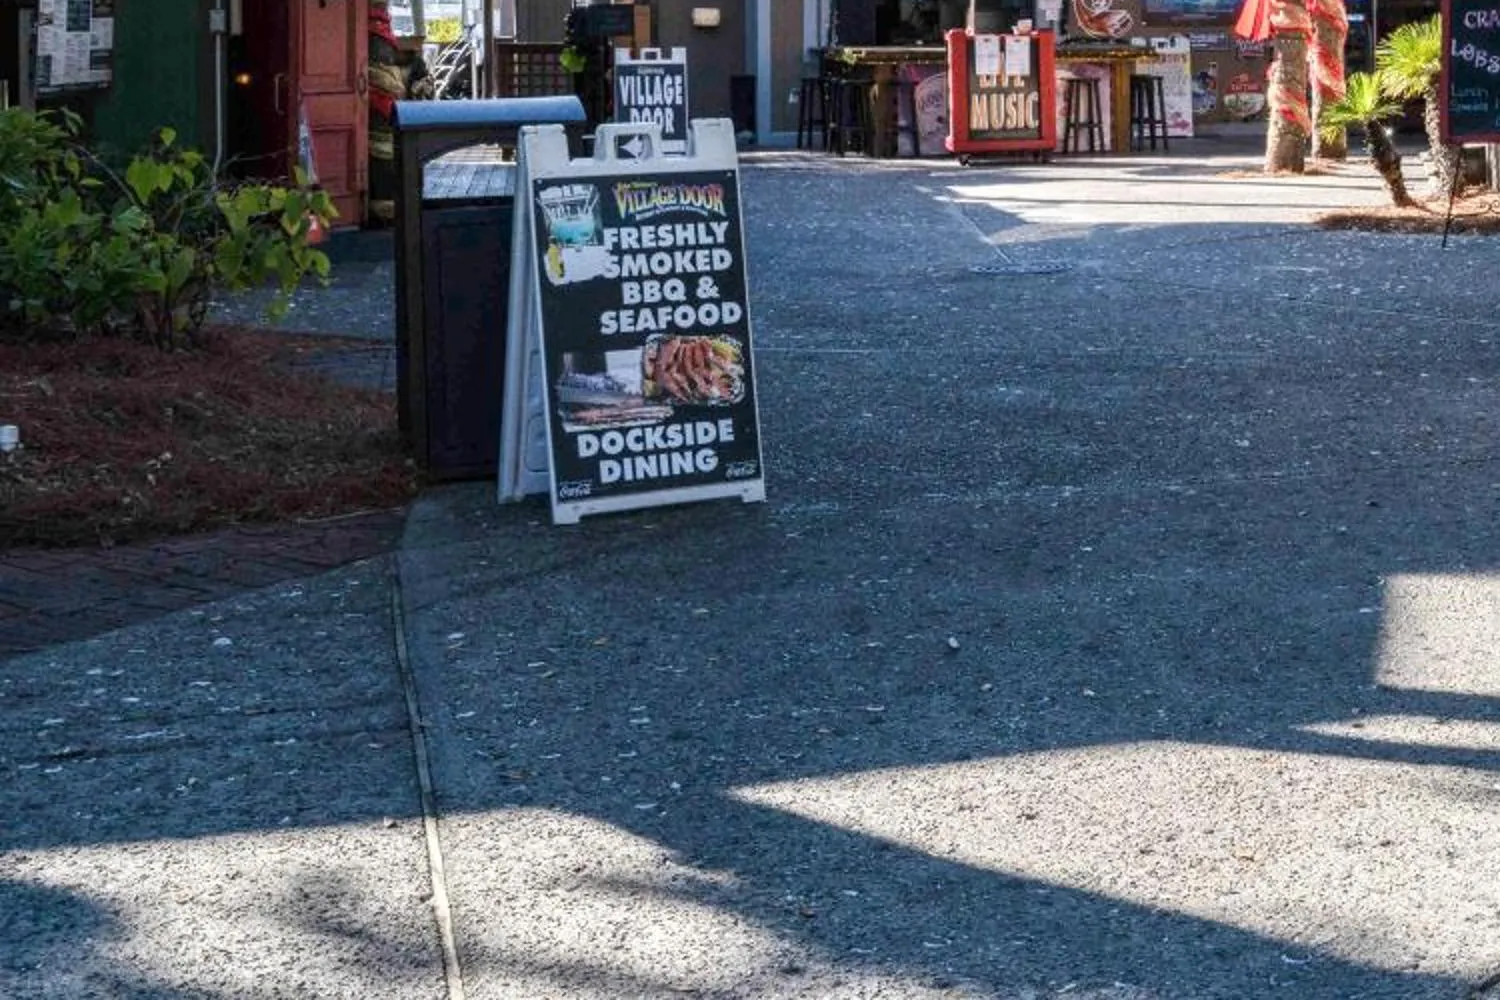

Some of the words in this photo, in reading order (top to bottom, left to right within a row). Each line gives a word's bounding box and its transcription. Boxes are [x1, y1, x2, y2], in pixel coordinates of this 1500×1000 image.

[619, 74, 683, 106] VILLAGE
[630, 106, 675, 133] DOOR
[970, 91, 1039, 130] MUSIC
[611, 184, 678, 219] VILLAGE
[680, 183, 727, 217] DOOR
[604, 221, 729, 250] FRESHLY
[604, 248, 733, 279] SMOKED
[622, 278, 686, 305] BBQ
[695, 276, 720, 299] &
[600, 301, 742, 335] SEAFOOD
[577, 418, 735, 459] DOCKSIDE
[600, 448, 719, 484] DINING
